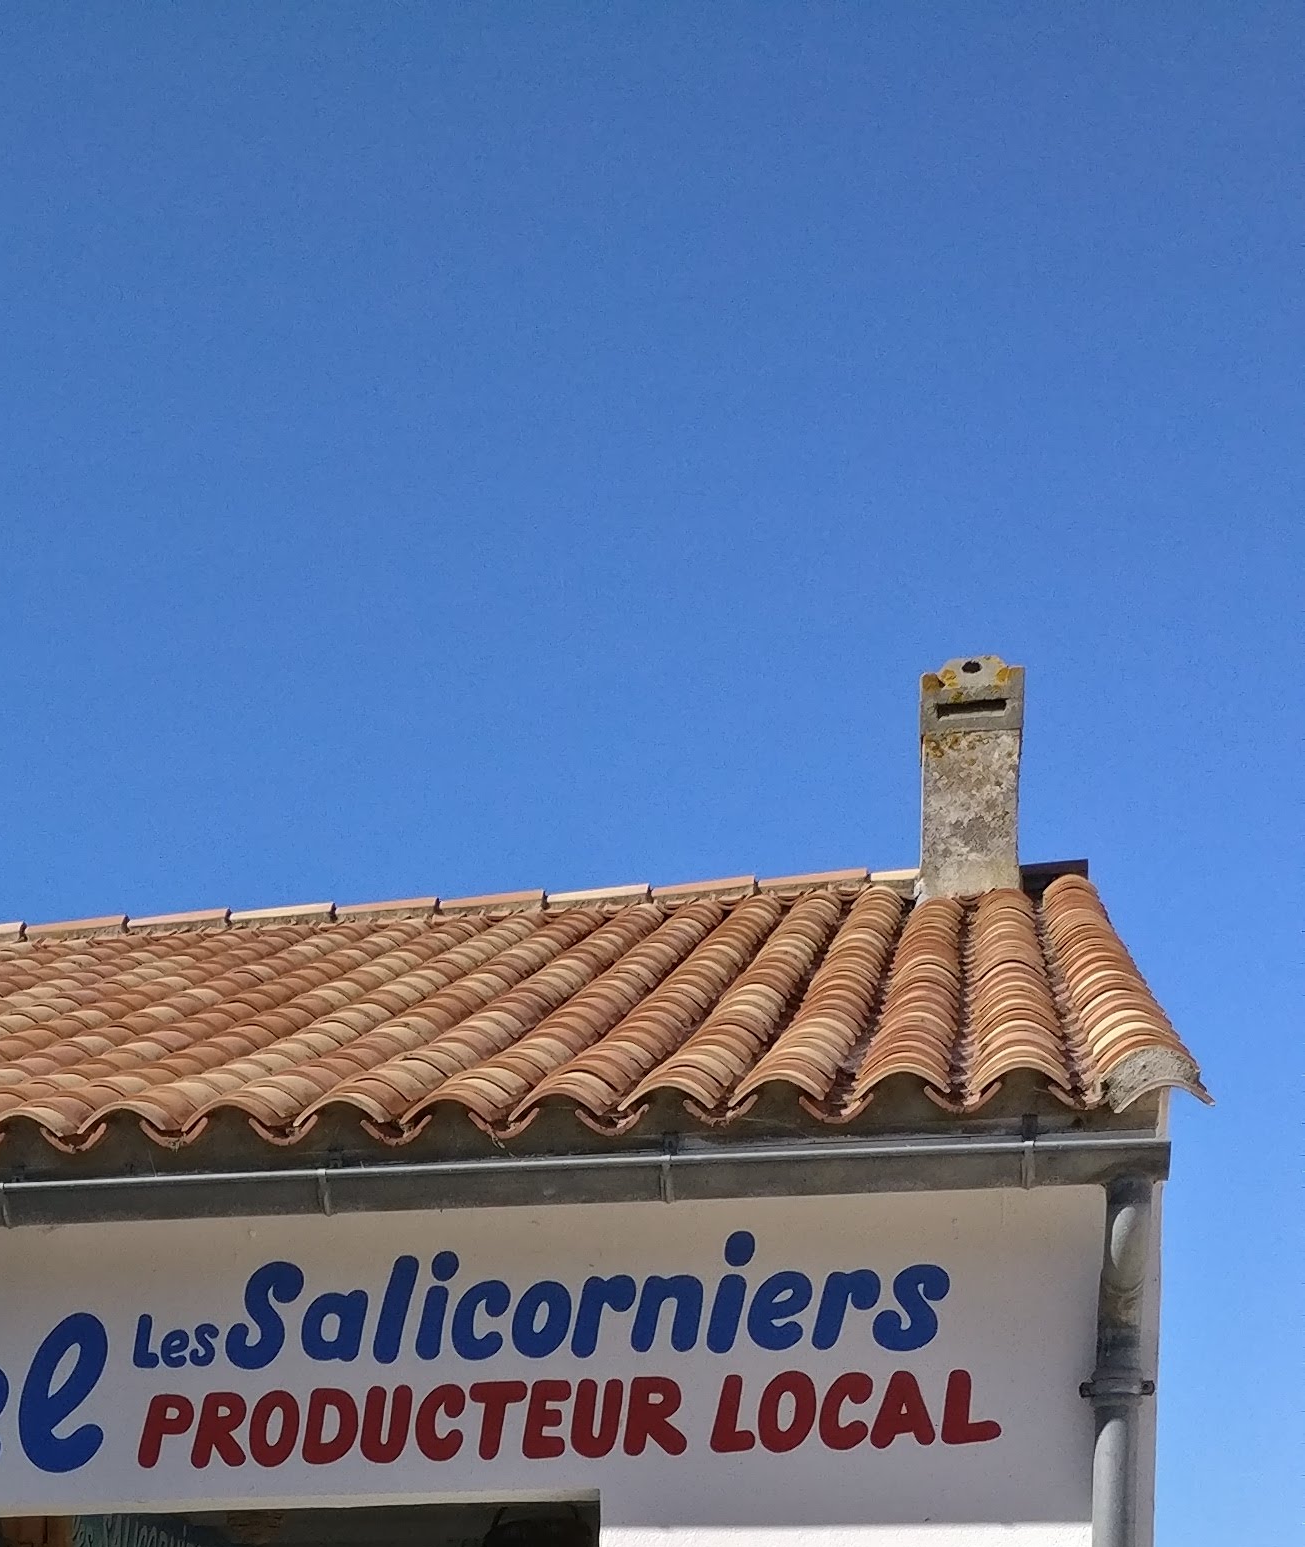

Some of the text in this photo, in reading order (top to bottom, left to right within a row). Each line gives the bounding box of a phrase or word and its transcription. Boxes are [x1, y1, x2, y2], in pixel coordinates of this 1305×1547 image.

[225, 1229, 951, 1371] Salicorniers
[136, 1368, 1002, 1470] PRODUCTEUR LOCAL
